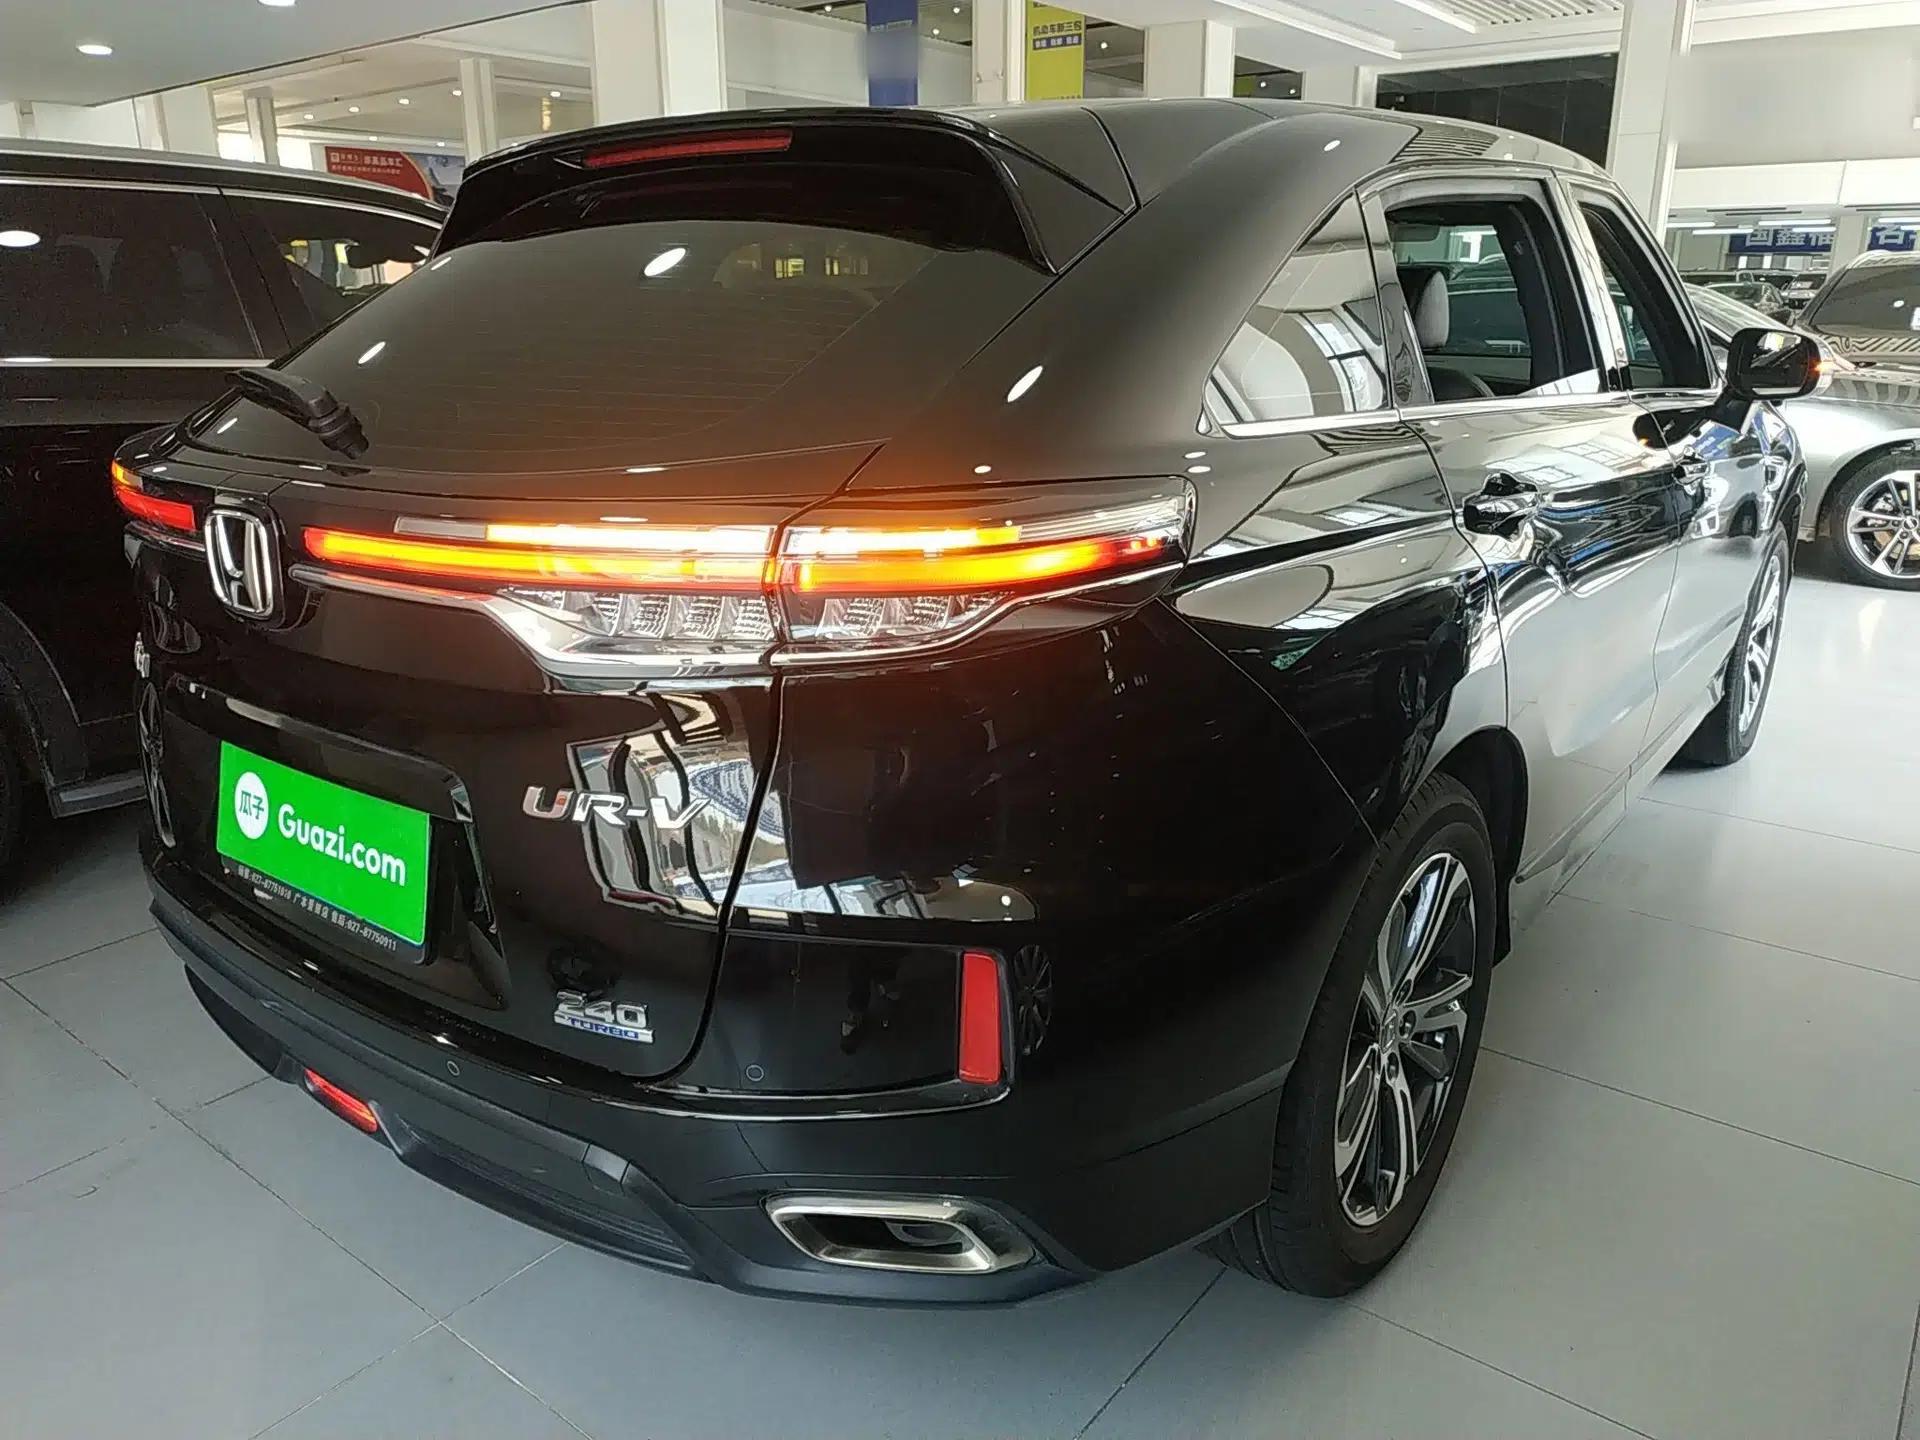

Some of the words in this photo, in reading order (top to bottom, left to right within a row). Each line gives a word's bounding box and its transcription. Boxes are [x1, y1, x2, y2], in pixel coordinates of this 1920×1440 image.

[238, 789, 265, 820] 瓜子
[522, 785, 712, 829] UR-V
[278, 803, 406, 887] Guazi.com
[556, 990, 648, 1029] 240
[568, 1016, 639, 1040] TURBO
